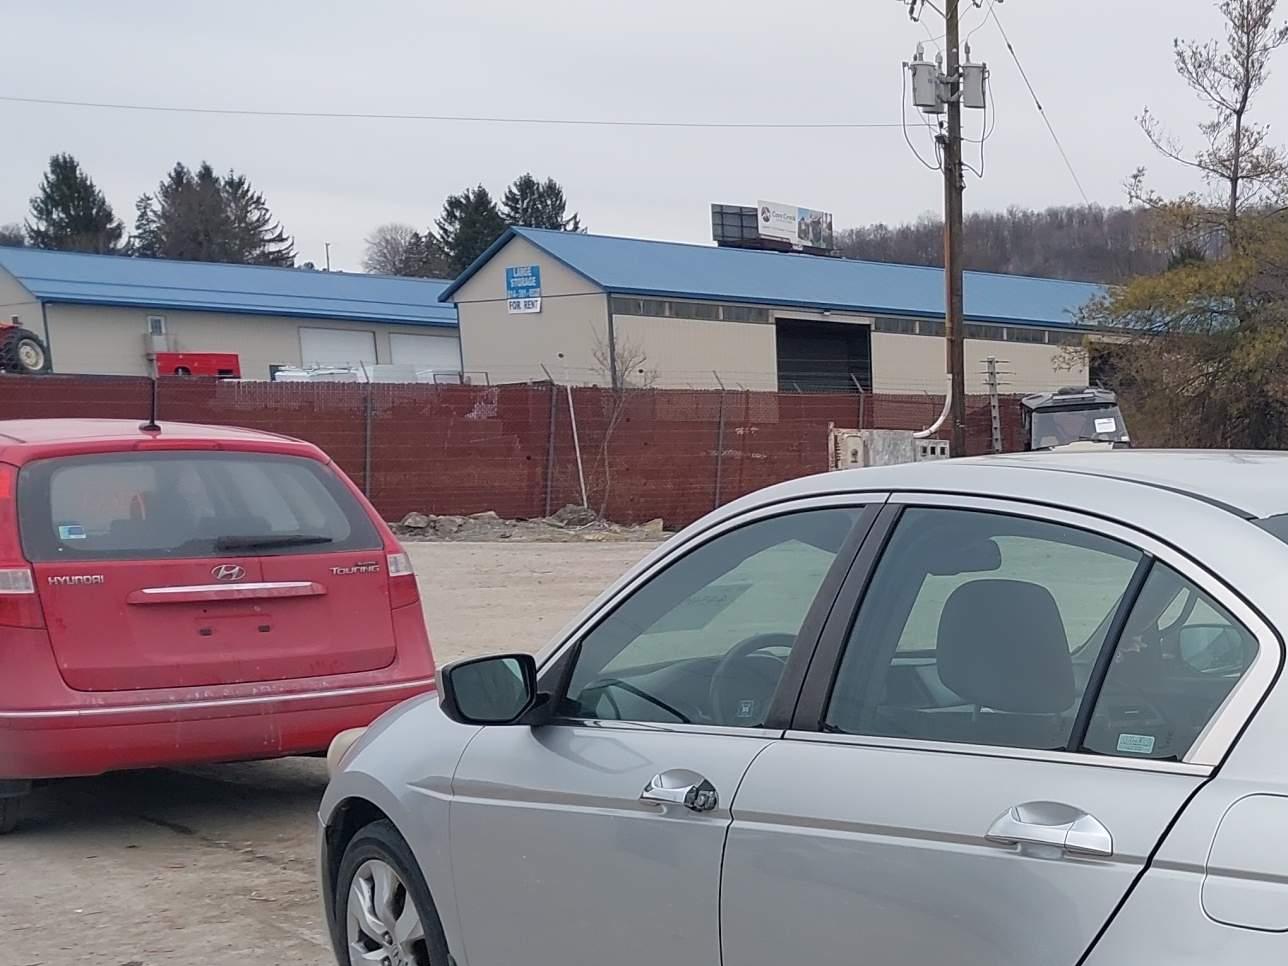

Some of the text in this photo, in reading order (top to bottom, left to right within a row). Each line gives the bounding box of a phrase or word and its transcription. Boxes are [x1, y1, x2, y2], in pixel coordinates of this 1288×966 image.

[510, 276, 537, 288] STORAGE
[509, 299, 539, 310] FOR RENT
[47, 575, 104, 585] HYUNDAI
